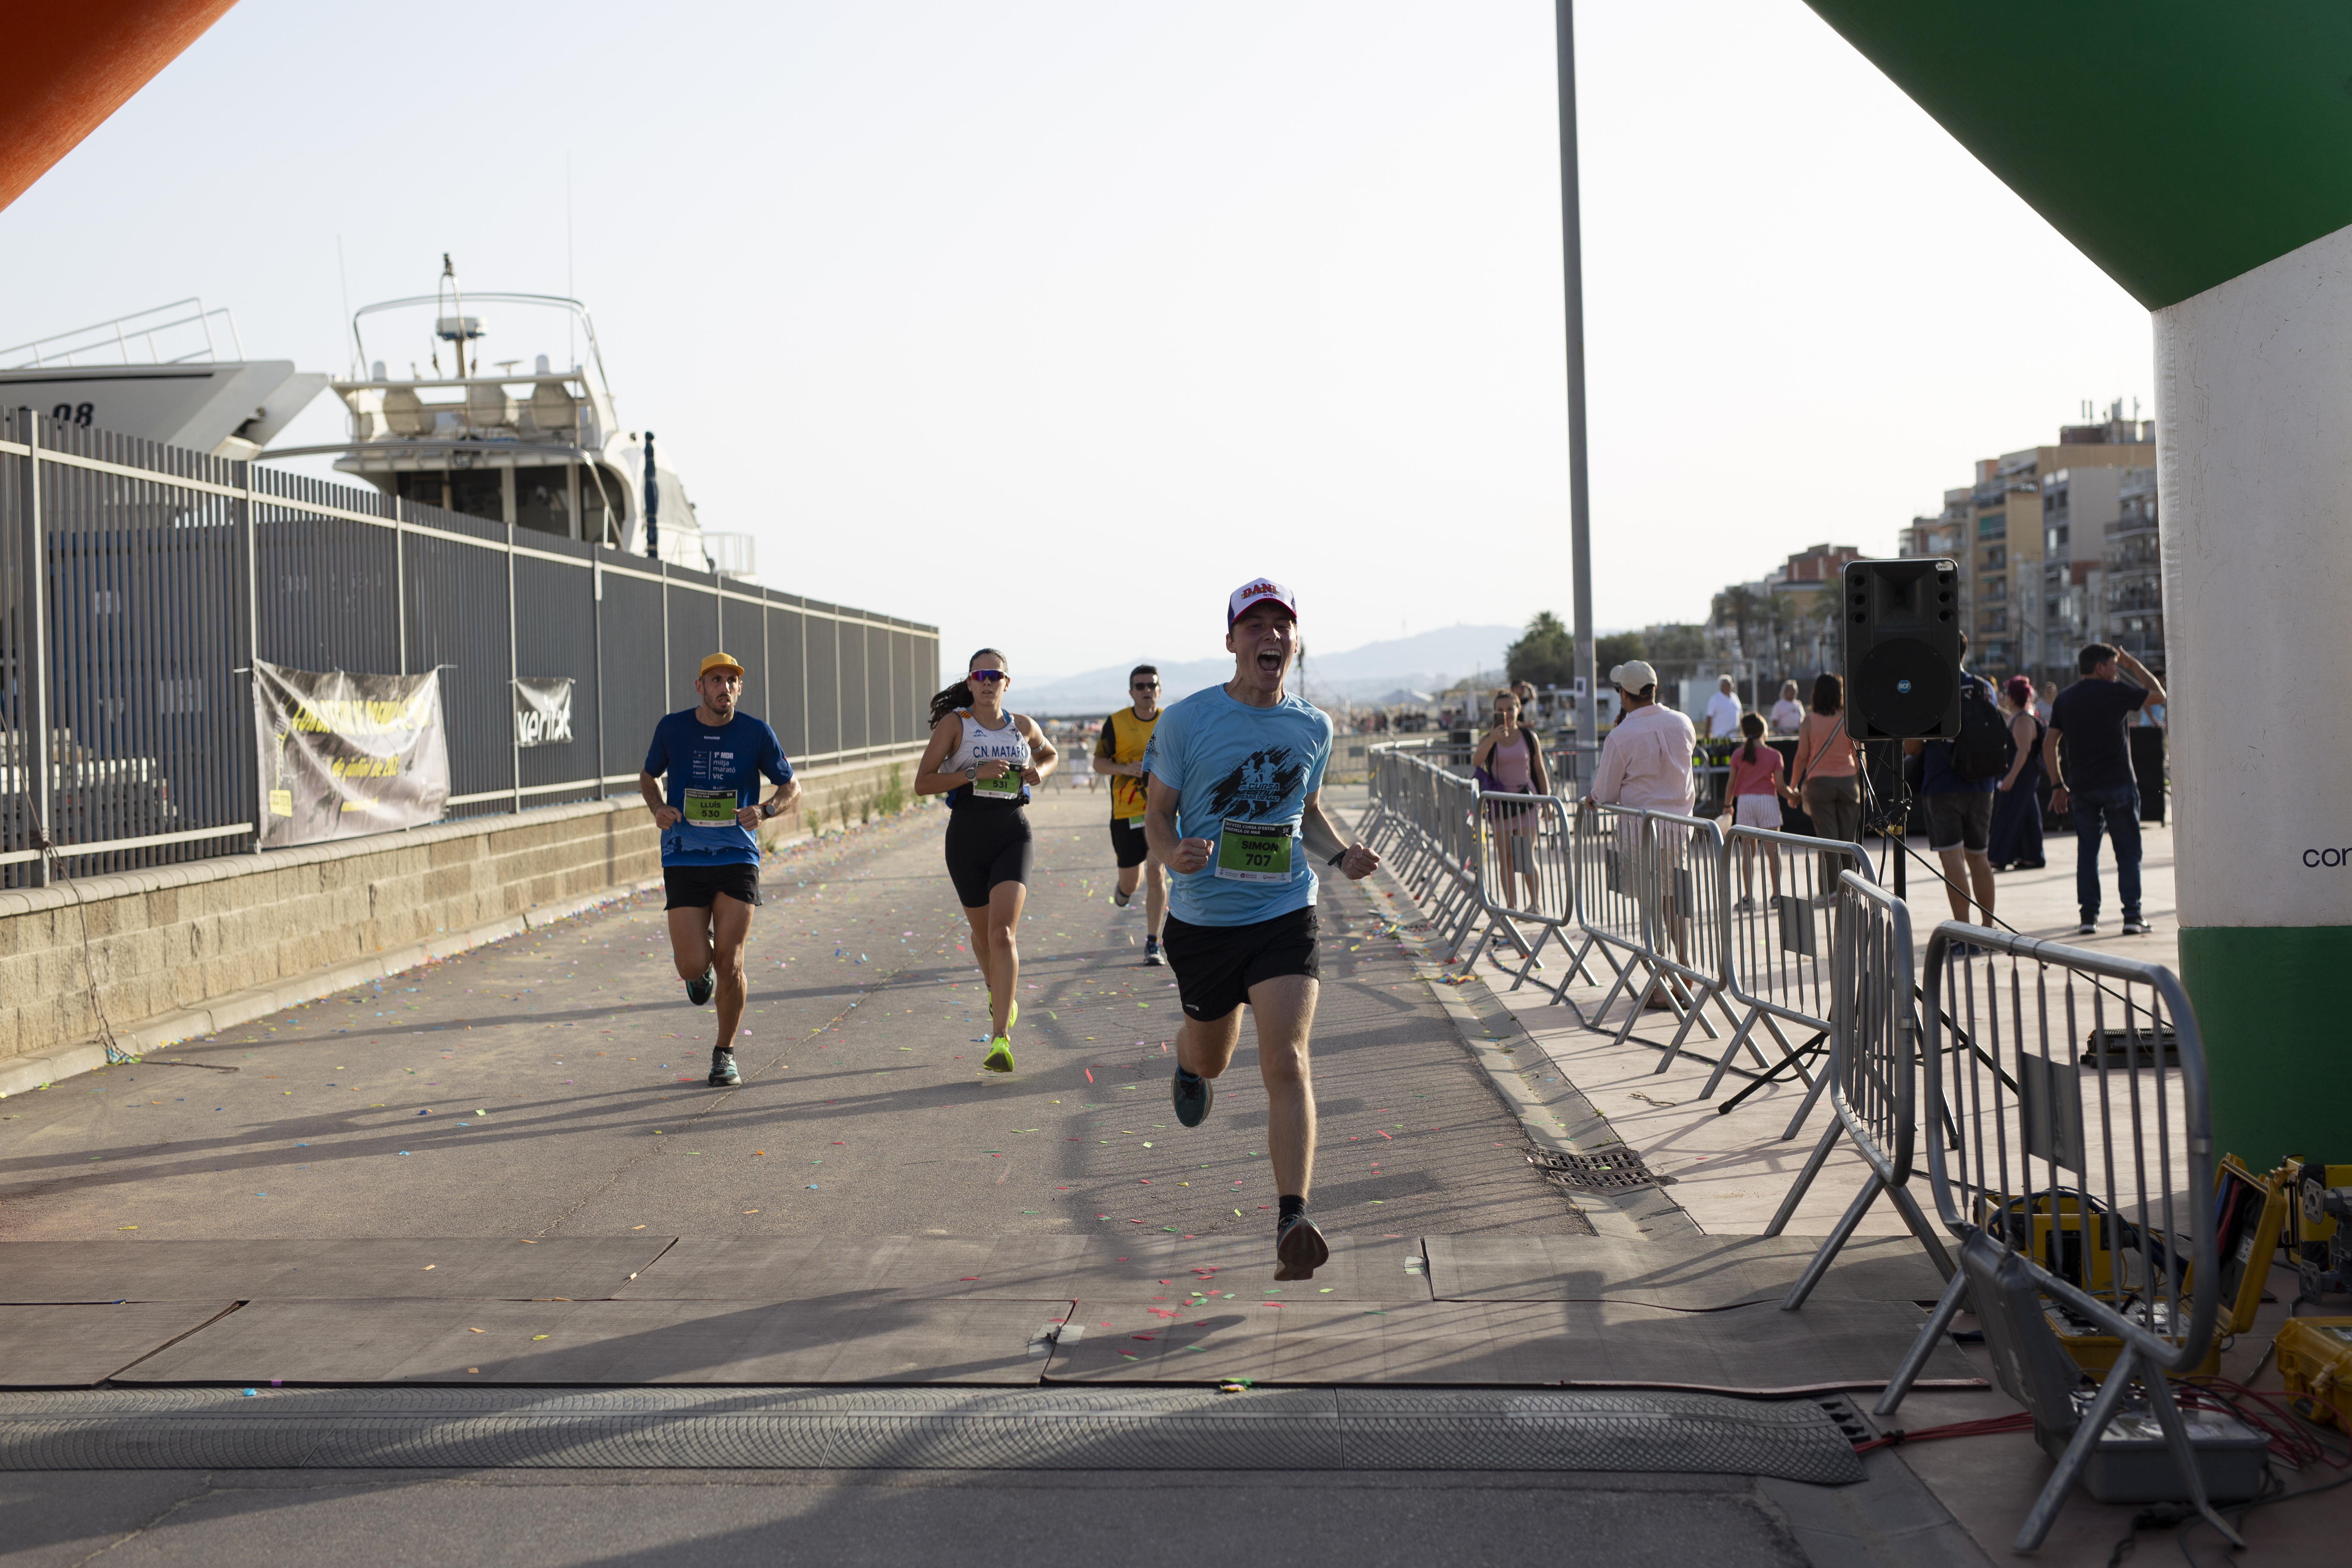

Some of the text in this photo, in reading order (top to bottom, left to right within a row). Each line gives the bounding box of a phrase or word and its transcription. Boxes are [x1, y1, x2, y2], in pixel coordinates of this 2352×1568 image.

[1243, 583, 1277, 599] DANI
[993, 780, 1007, 788] 531
[1241, 840, 1279, 851] SIMON
[1246, 853, 1271, 867] 707
